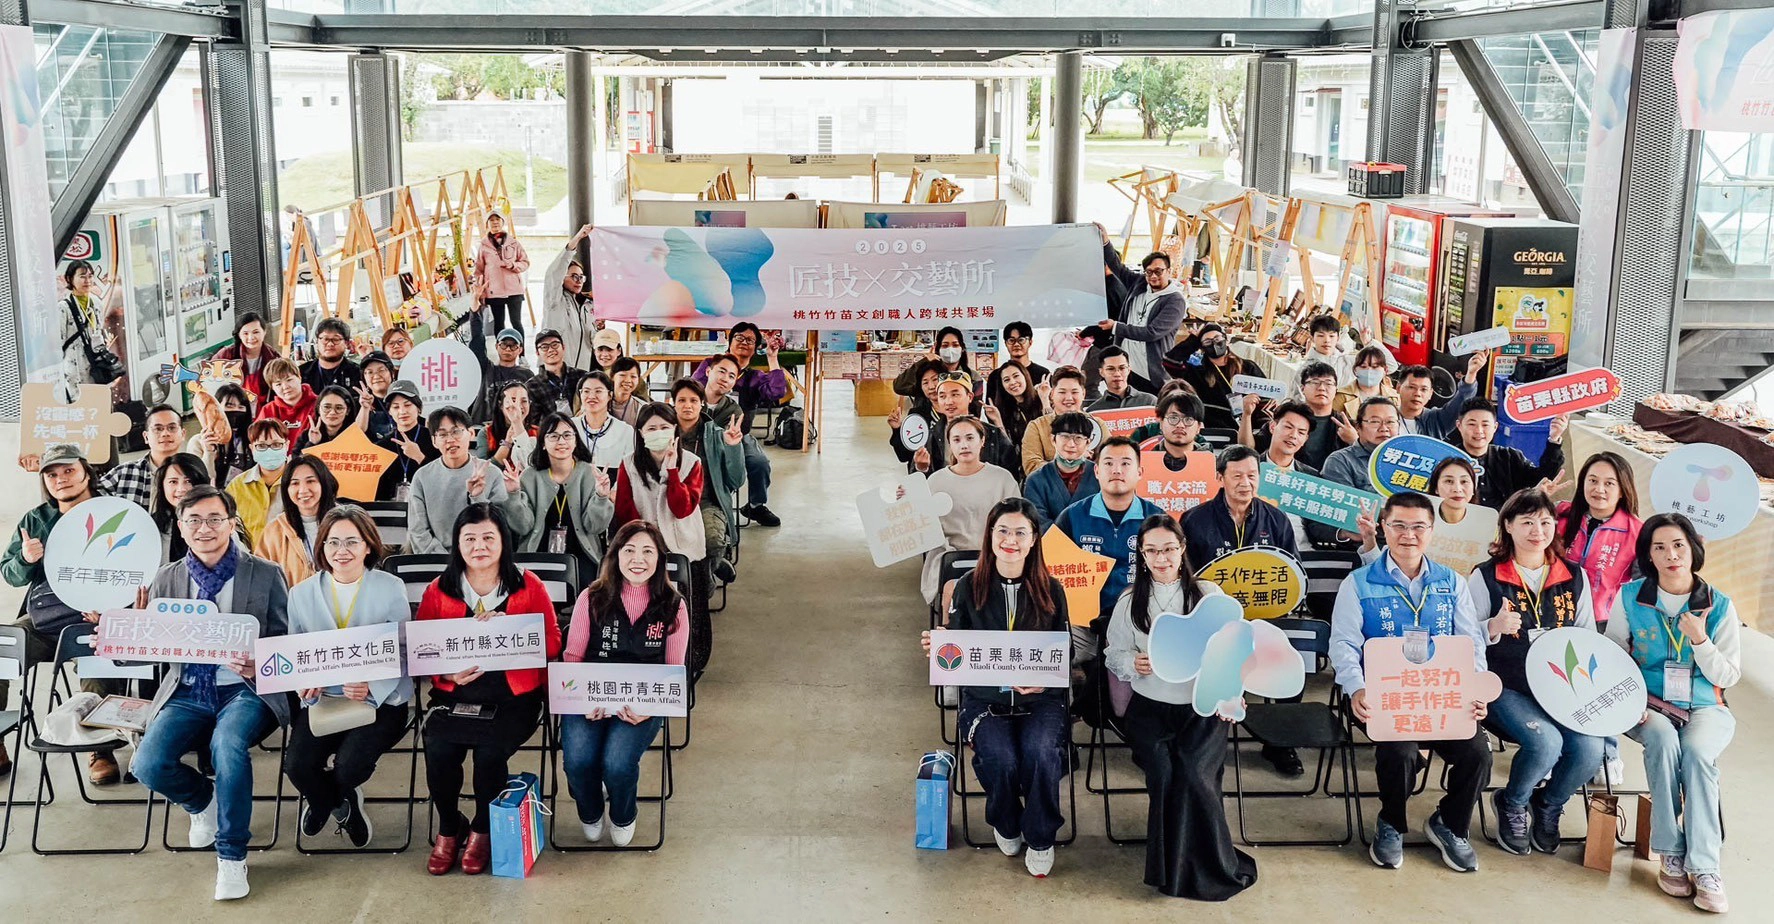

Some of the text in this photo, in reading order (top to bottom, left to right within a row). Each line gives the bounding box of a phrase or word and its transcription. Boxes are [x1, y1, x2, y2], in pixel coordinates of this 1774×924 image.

[1513, 250, 1565, 262] GEORGIA
[788, 258, 996, 299] 匠技×交藝所
[793, 306, 995, 320] 桃竹竹苗文創職人跨域共聚場
[1515, 377, 1609, 414] 苗栗縣政府
[34, 424, 99, 439] 先喝一杯
[320, 452, 378, 462] 感謝每雙巧手
[1147, 480, 1207, 495] 職人交流
[1672, 500, 1726, 522] 桃藝工坊
[57, 566, 144, 586] 青年事務局
[1213, 565, 1288, 586] 手作生活
[157, 602, 208, 615] 2025
[446, 632, 540, 652] 新竹縣文化局
[296, 639, 395, 665] 新竹市文化局
[969, 647, 1063, 663] 苗栗縣政府
[297, 665, 320, 674] Cultural
[969, 662, 1060, 672] Miaoli County Government
[1381, 668, 1461, 687] 一起努力
[587, 680, 681, 697] 桃園市青年局
[1381, 691, 1462, 710] 讓手作走
[1571, 676, 1640, 726] 青年事務局
[1392, 714, 1447, 733] 更遠！
